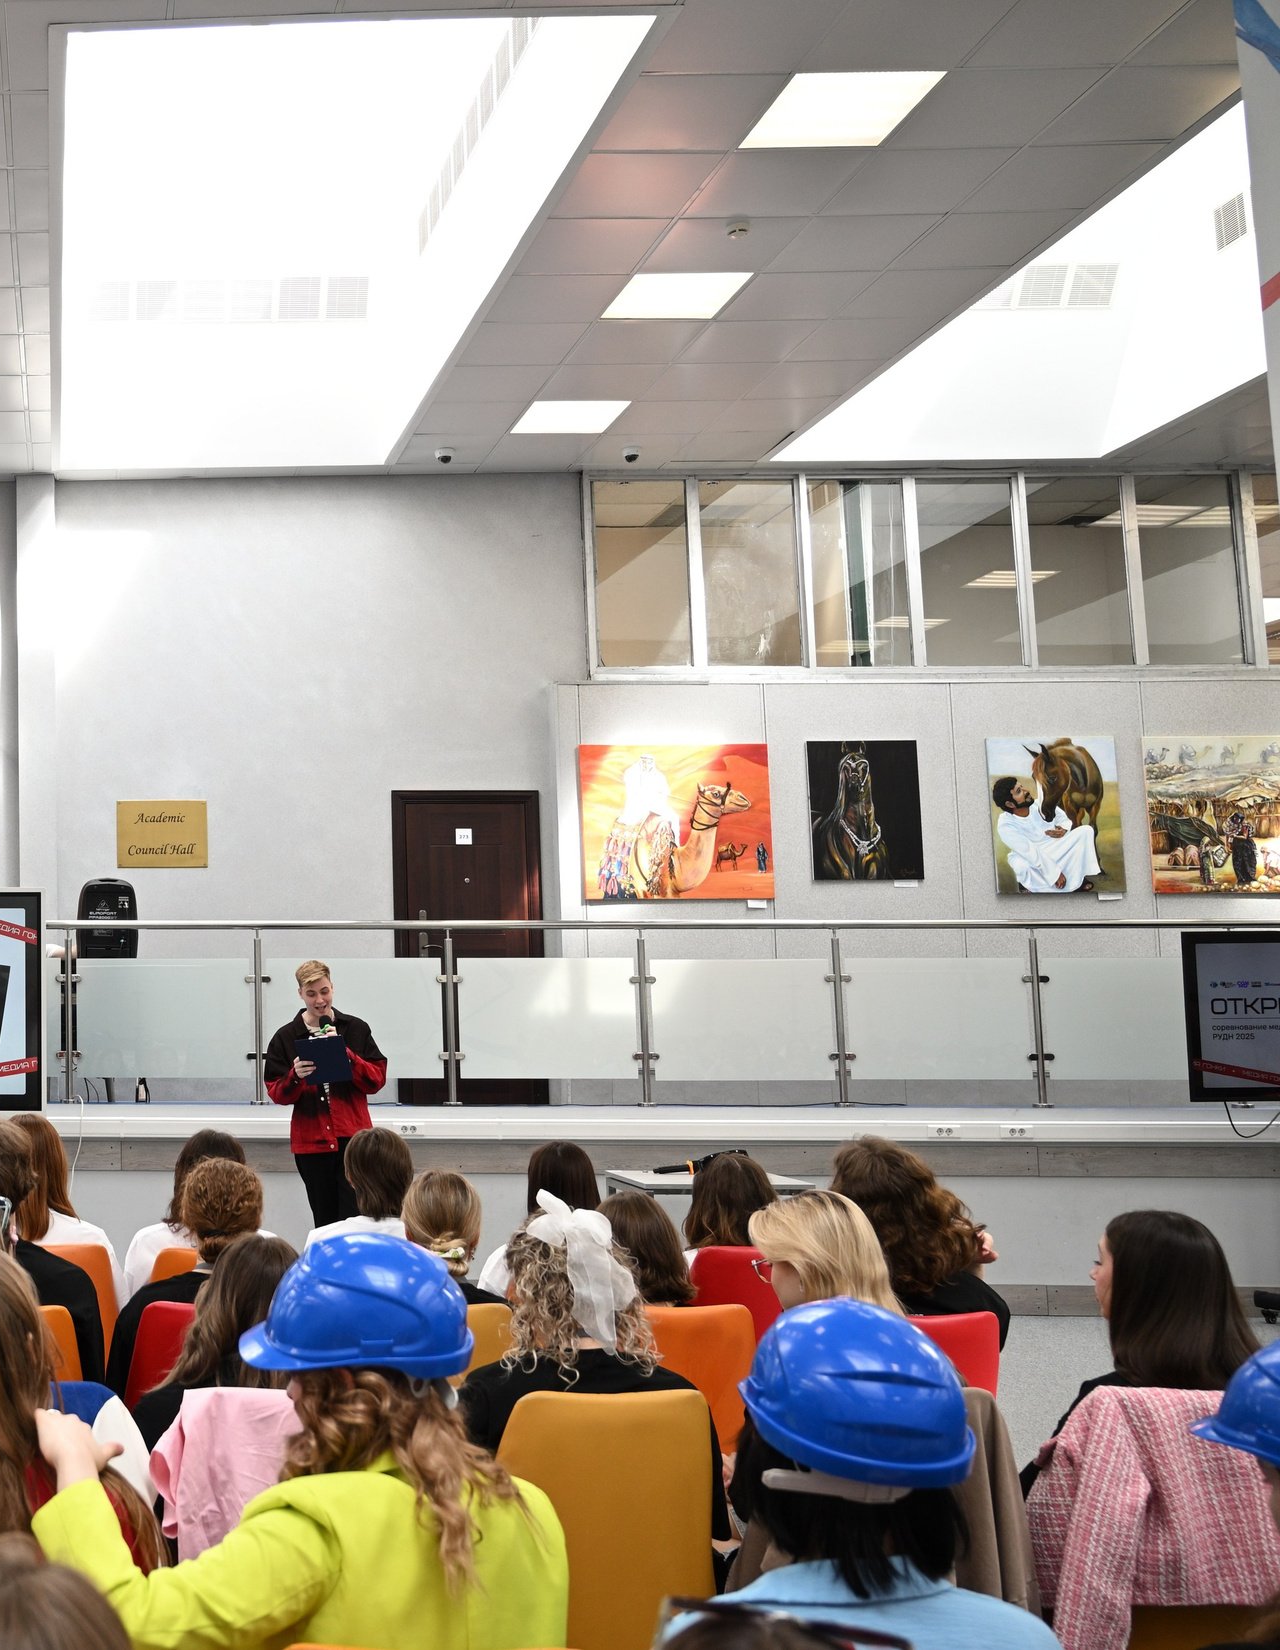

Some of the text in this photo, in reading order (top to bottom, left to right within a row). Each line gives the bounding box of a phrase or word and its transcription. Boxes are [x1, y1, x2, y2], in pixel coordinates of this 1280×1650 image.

[134, 812, 185, 824] Academic
[128, 843, 196, 856] Council Hall
[1210, 997, 1280, 1015] ОТКР
[1212, 1024, 1268, 1032] соревнование
[1212, 1033, 1234, 1041] РУДН
